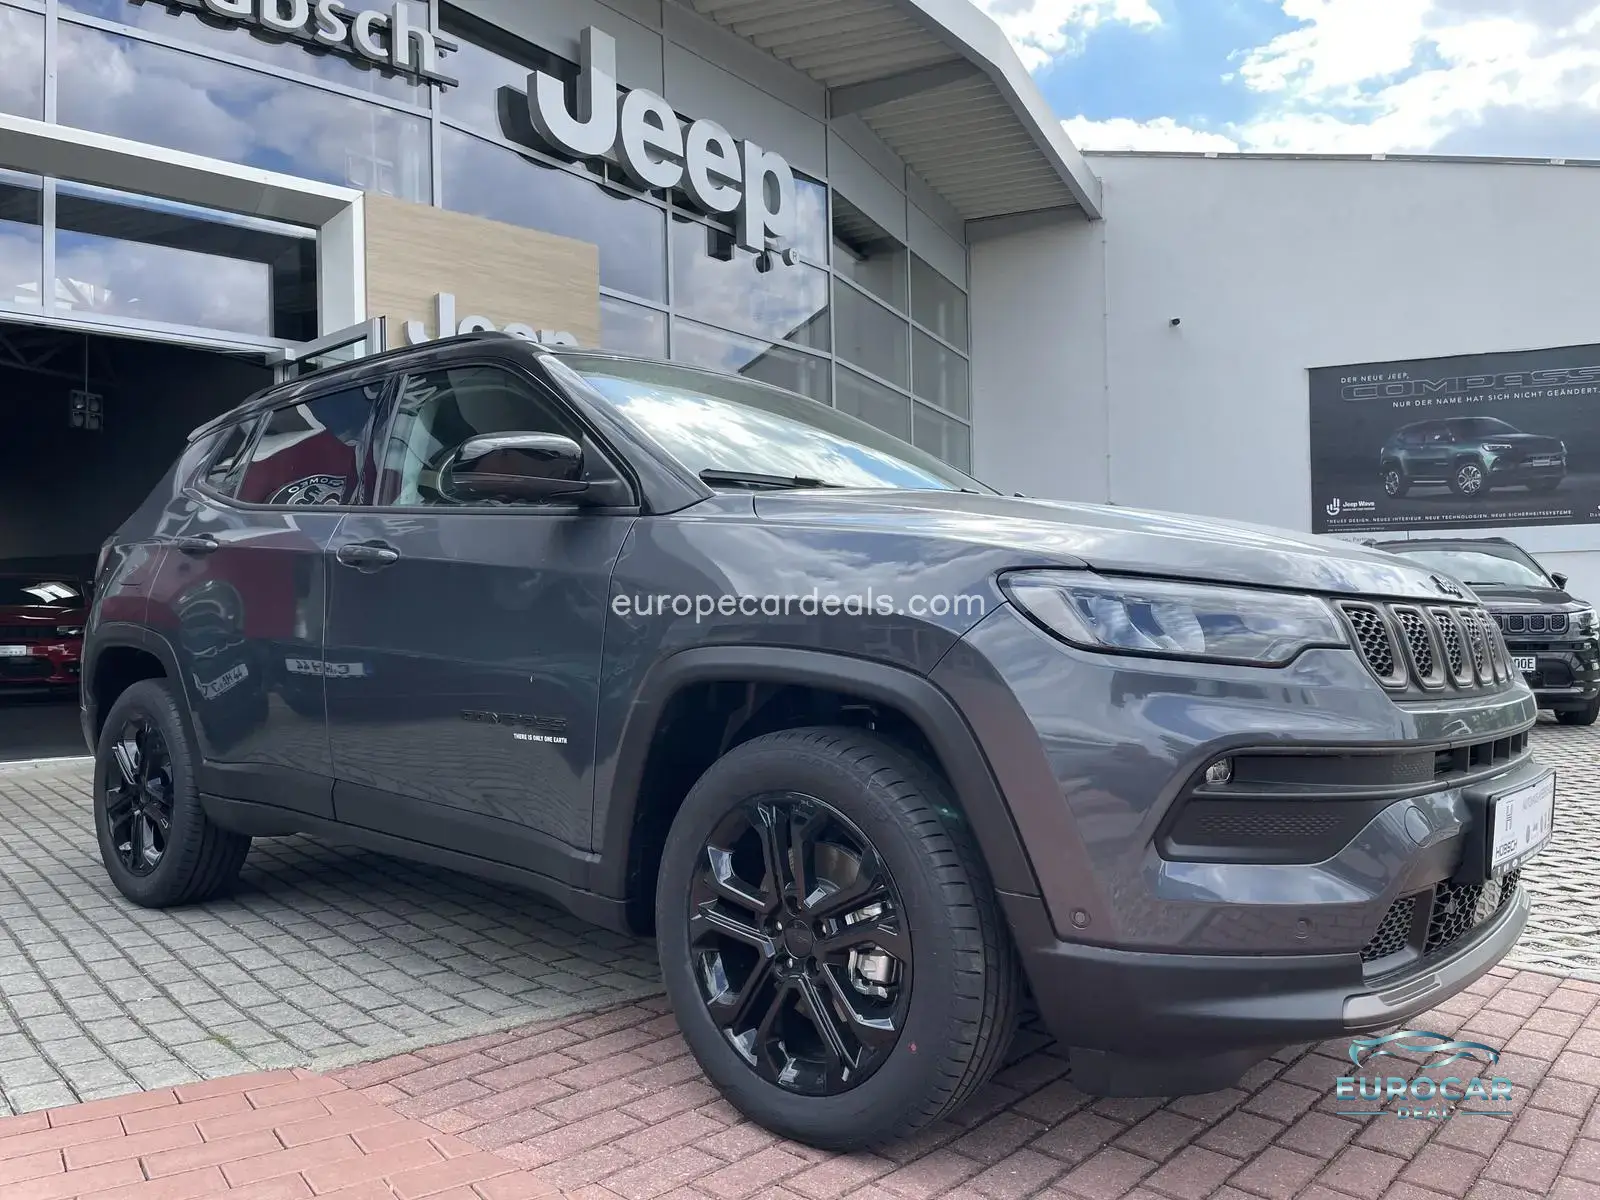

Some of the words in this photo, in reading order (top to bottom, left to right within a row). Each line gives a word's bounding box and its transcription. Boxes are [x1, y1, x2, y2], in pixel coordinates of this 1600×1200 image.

[527, 25, 798, 253] Jeep
[1341, 376, 1357, 384] DER
[1341, 366, 1600, 401] COMPASS
[1414, 399, 1432, 407] DER
[1436, 397, 1462, 405] NAME
[1488, 393, 1510, 401] SICH
[1514, 391, 1542, 399] NICHT
[544, 735, 553, 743] ONE
[553, 736, 568, 744] EARTH
